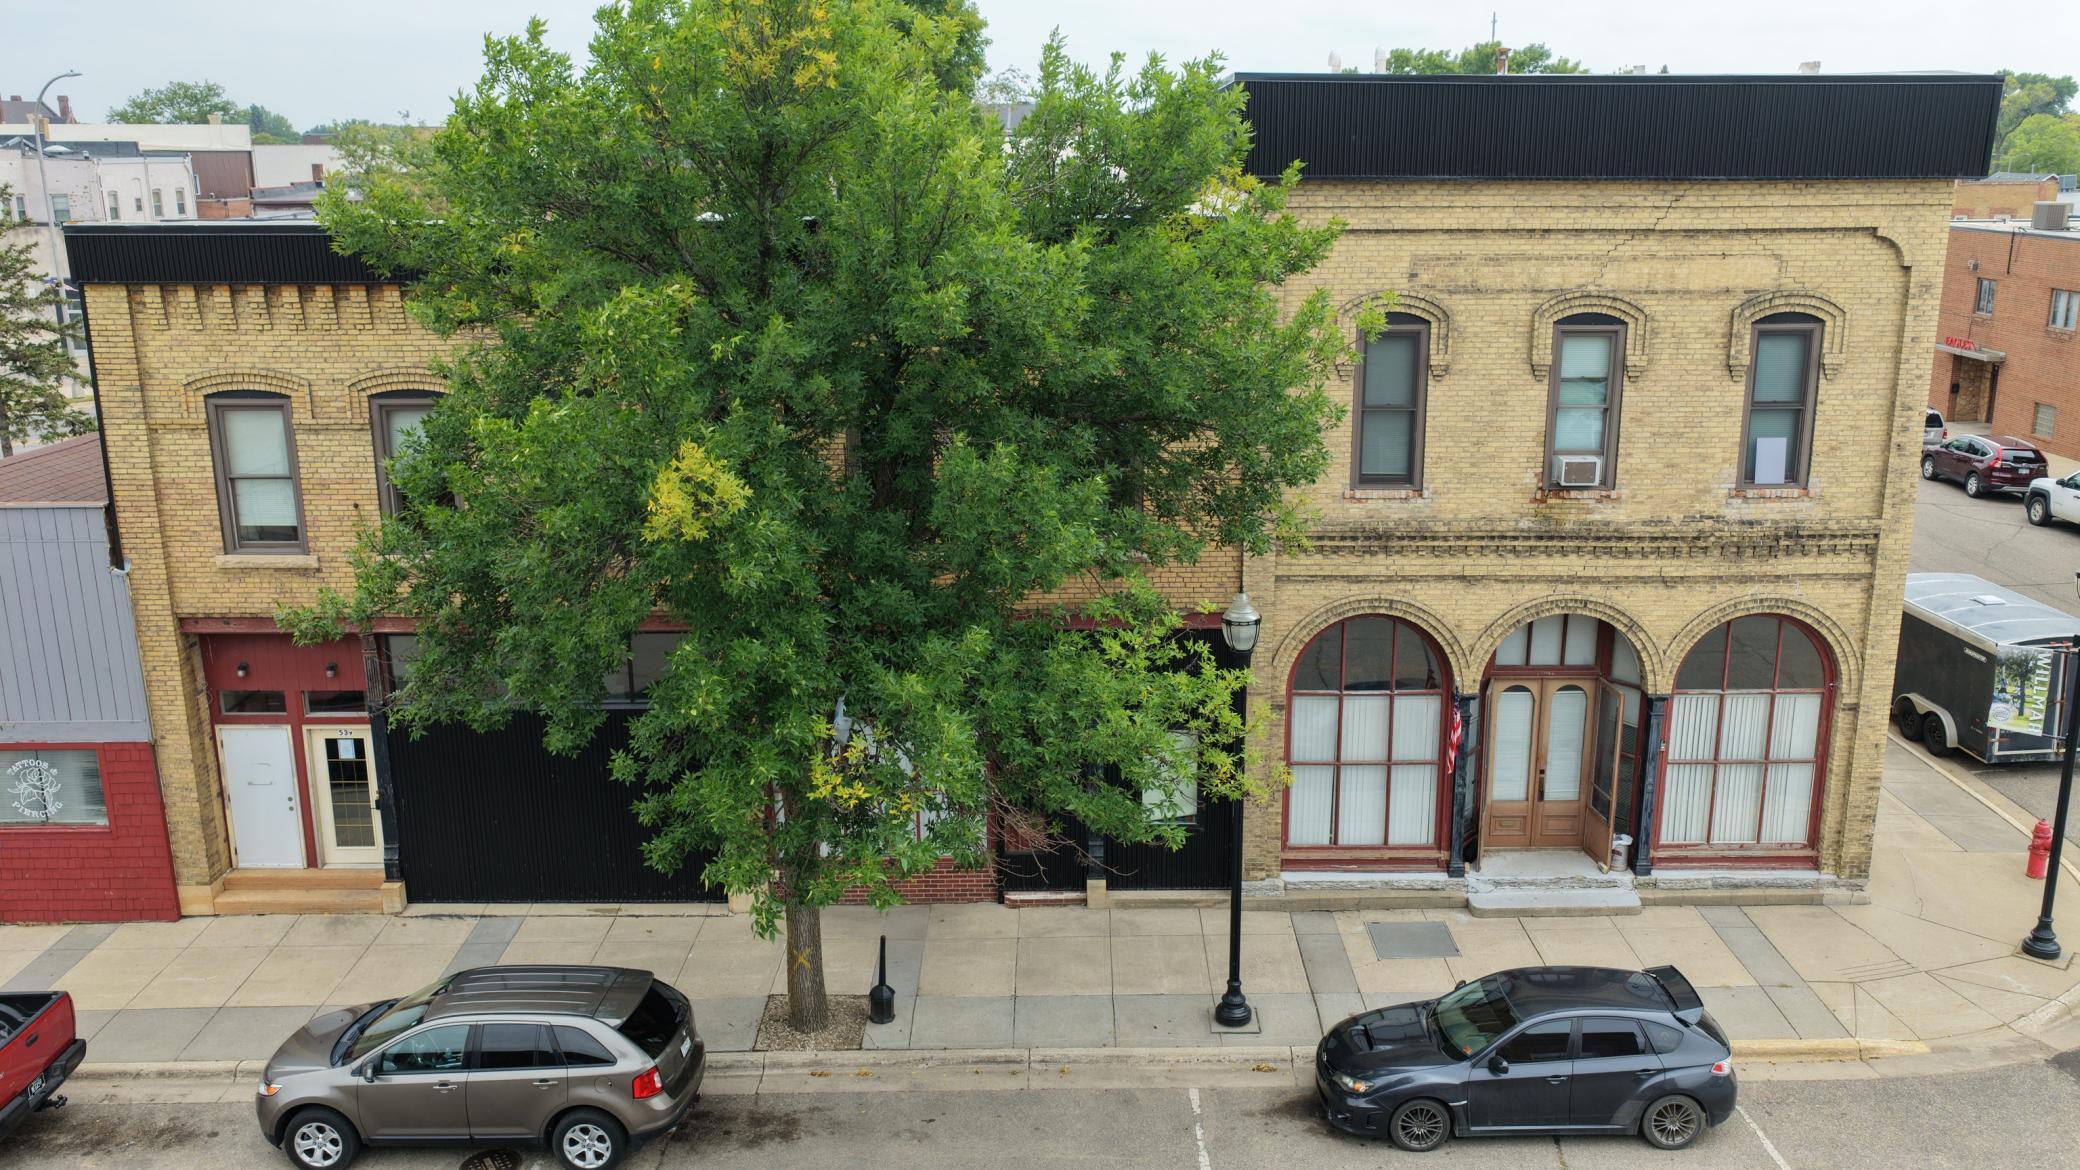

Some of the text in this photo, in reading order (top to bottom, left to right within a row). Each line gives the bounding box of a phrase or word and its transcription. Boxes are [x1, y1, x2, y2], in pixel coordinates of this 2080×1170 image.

[2027, 652, 2052, 736] WILLMAR
[7, 759, 49, 775] TATTOOS
[12, 801, 63, 818] PIERCING
